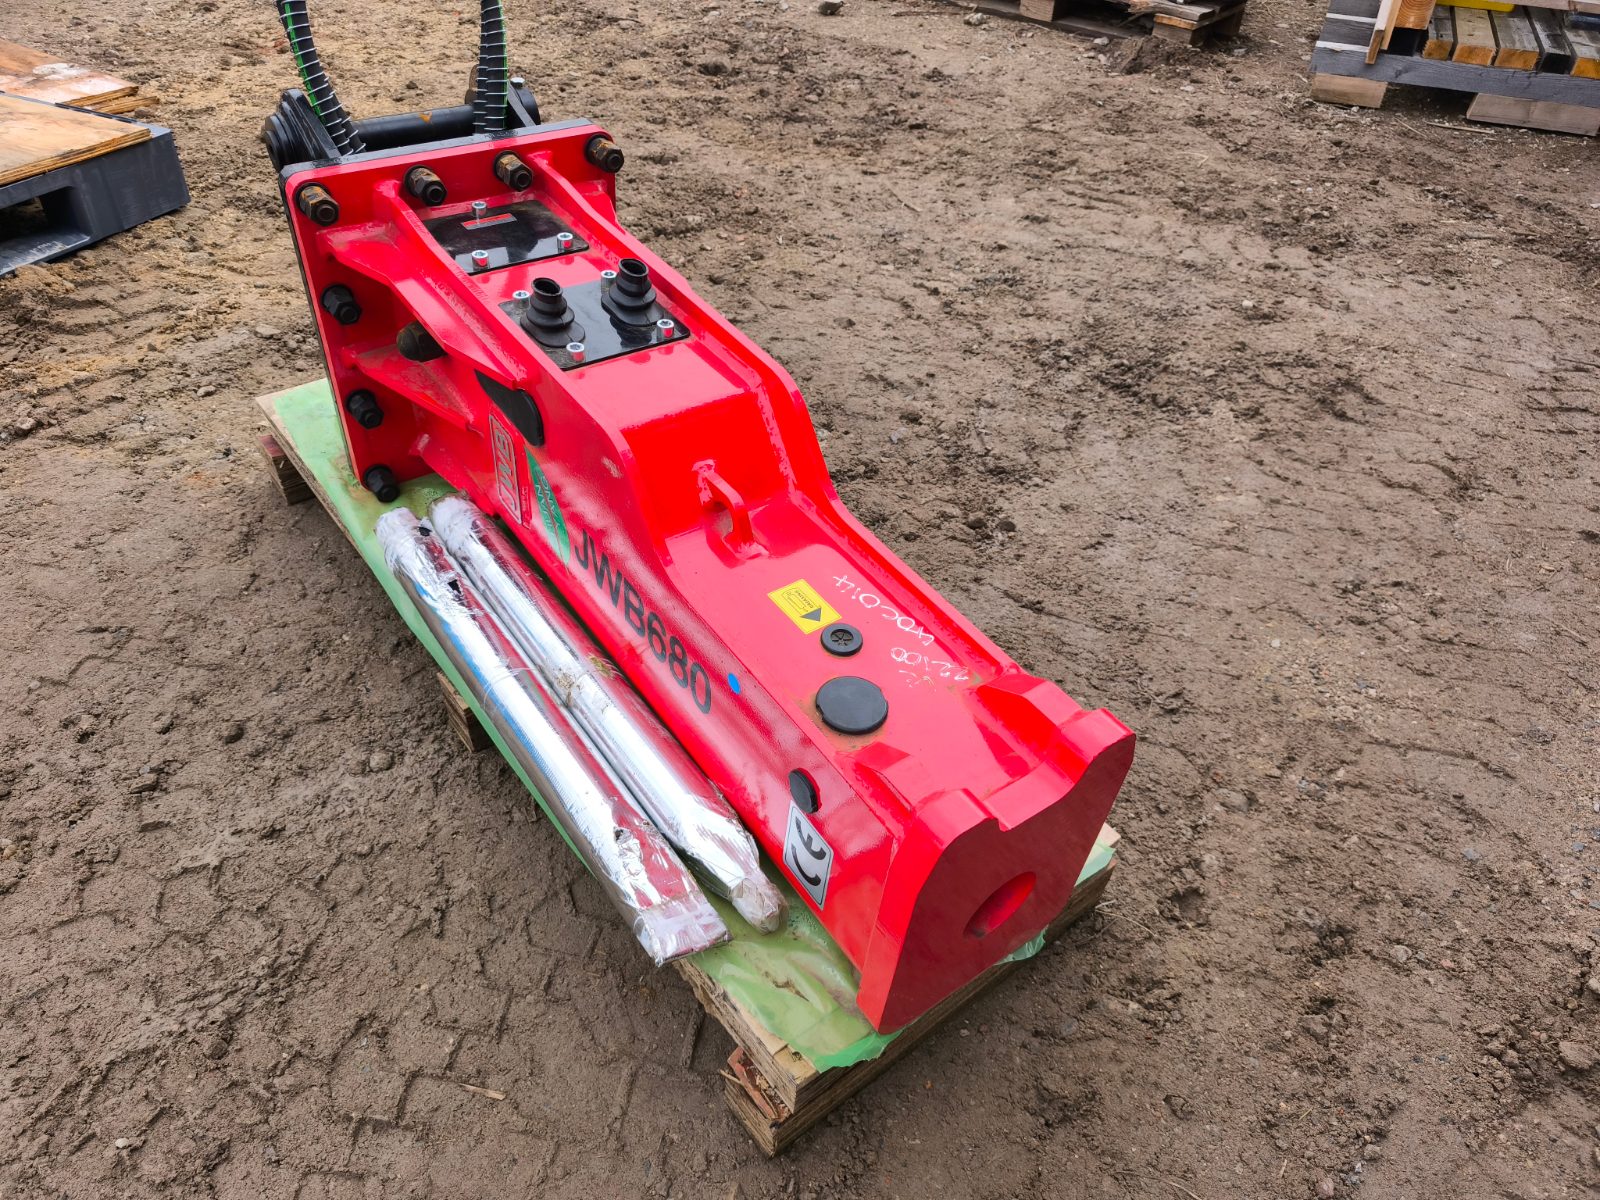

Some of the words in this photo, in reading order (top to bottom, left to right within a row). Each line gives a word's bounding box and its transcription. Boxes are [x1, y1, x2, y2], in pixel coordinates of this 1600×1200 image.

[495, 430, 517, 511] JWB
[574, 529, 712, 715] JWB680
[791, 815, 827, 887] CE
